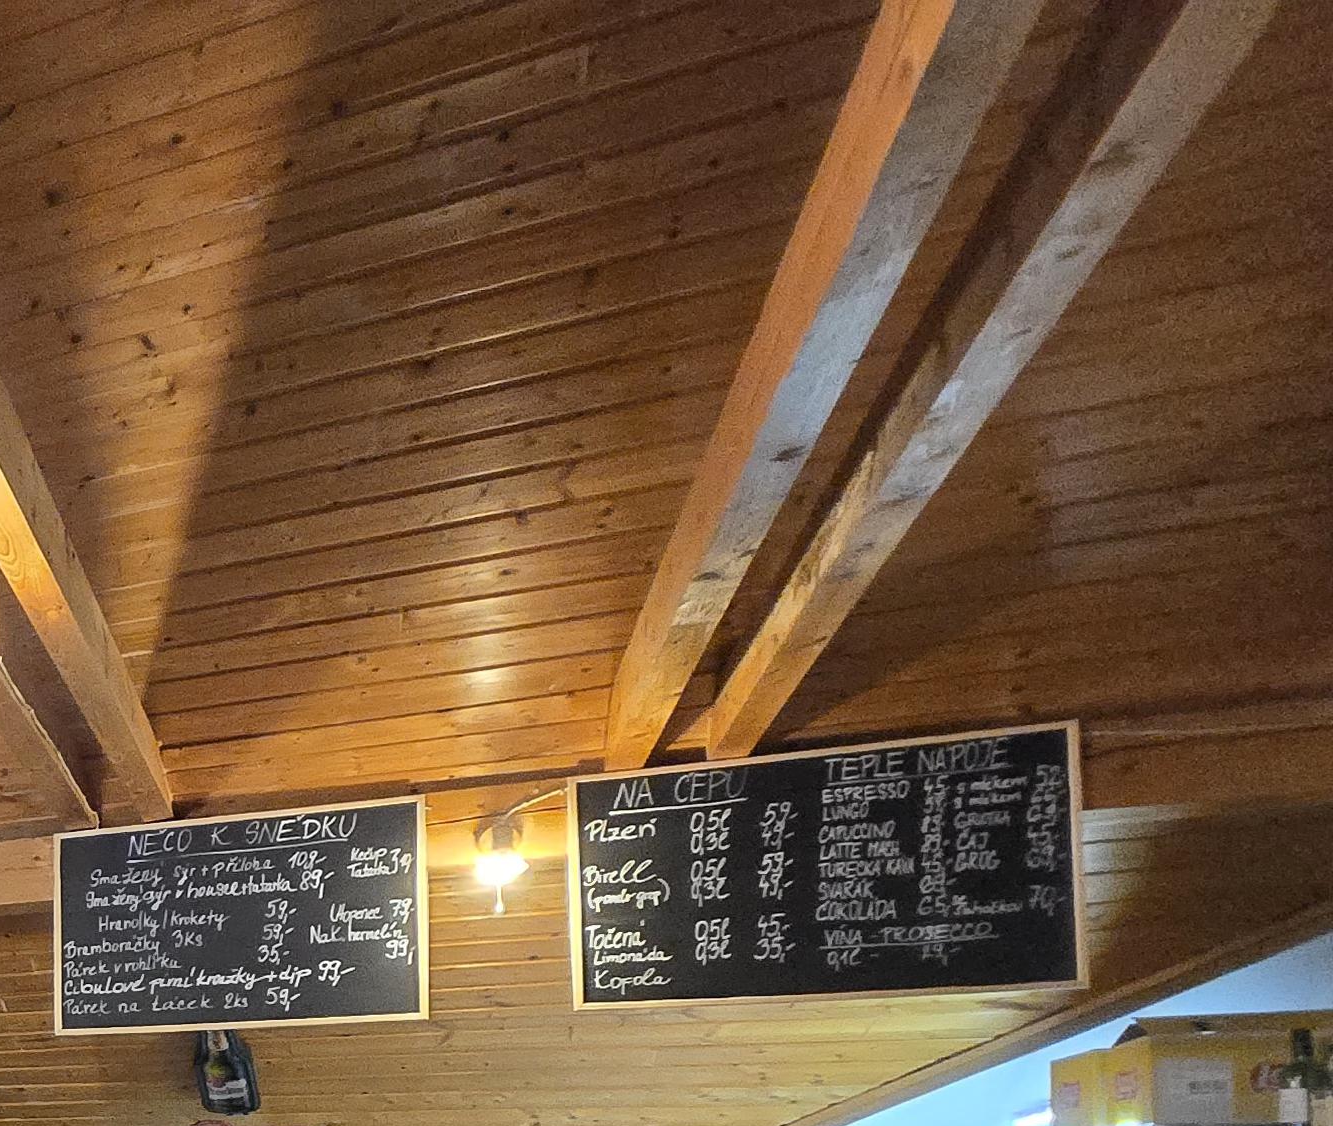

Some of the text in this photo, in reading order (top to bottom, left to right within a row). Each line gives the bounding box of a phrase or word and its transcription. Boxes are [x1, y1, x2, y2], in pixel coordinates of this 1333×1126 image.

[613, 777, 654, 809] NA
[822, 780, 910, 804] ESPRESSO
[822, 801, 869, 821] LUNGO
[211, 825, 234, 846] K
[820, 841, 863, 861] LATTE
[582, 859, 657, 887] Birell
[882, 922, 993, 943] PROSECCO
[64, 960, 111, 978] Párek
[279, 964, 313, 988] dip
[593, 967, 673, 995] Kofola
[63, 998, 112, 1015] Párek
[118, 1002, 141, 1013] na
